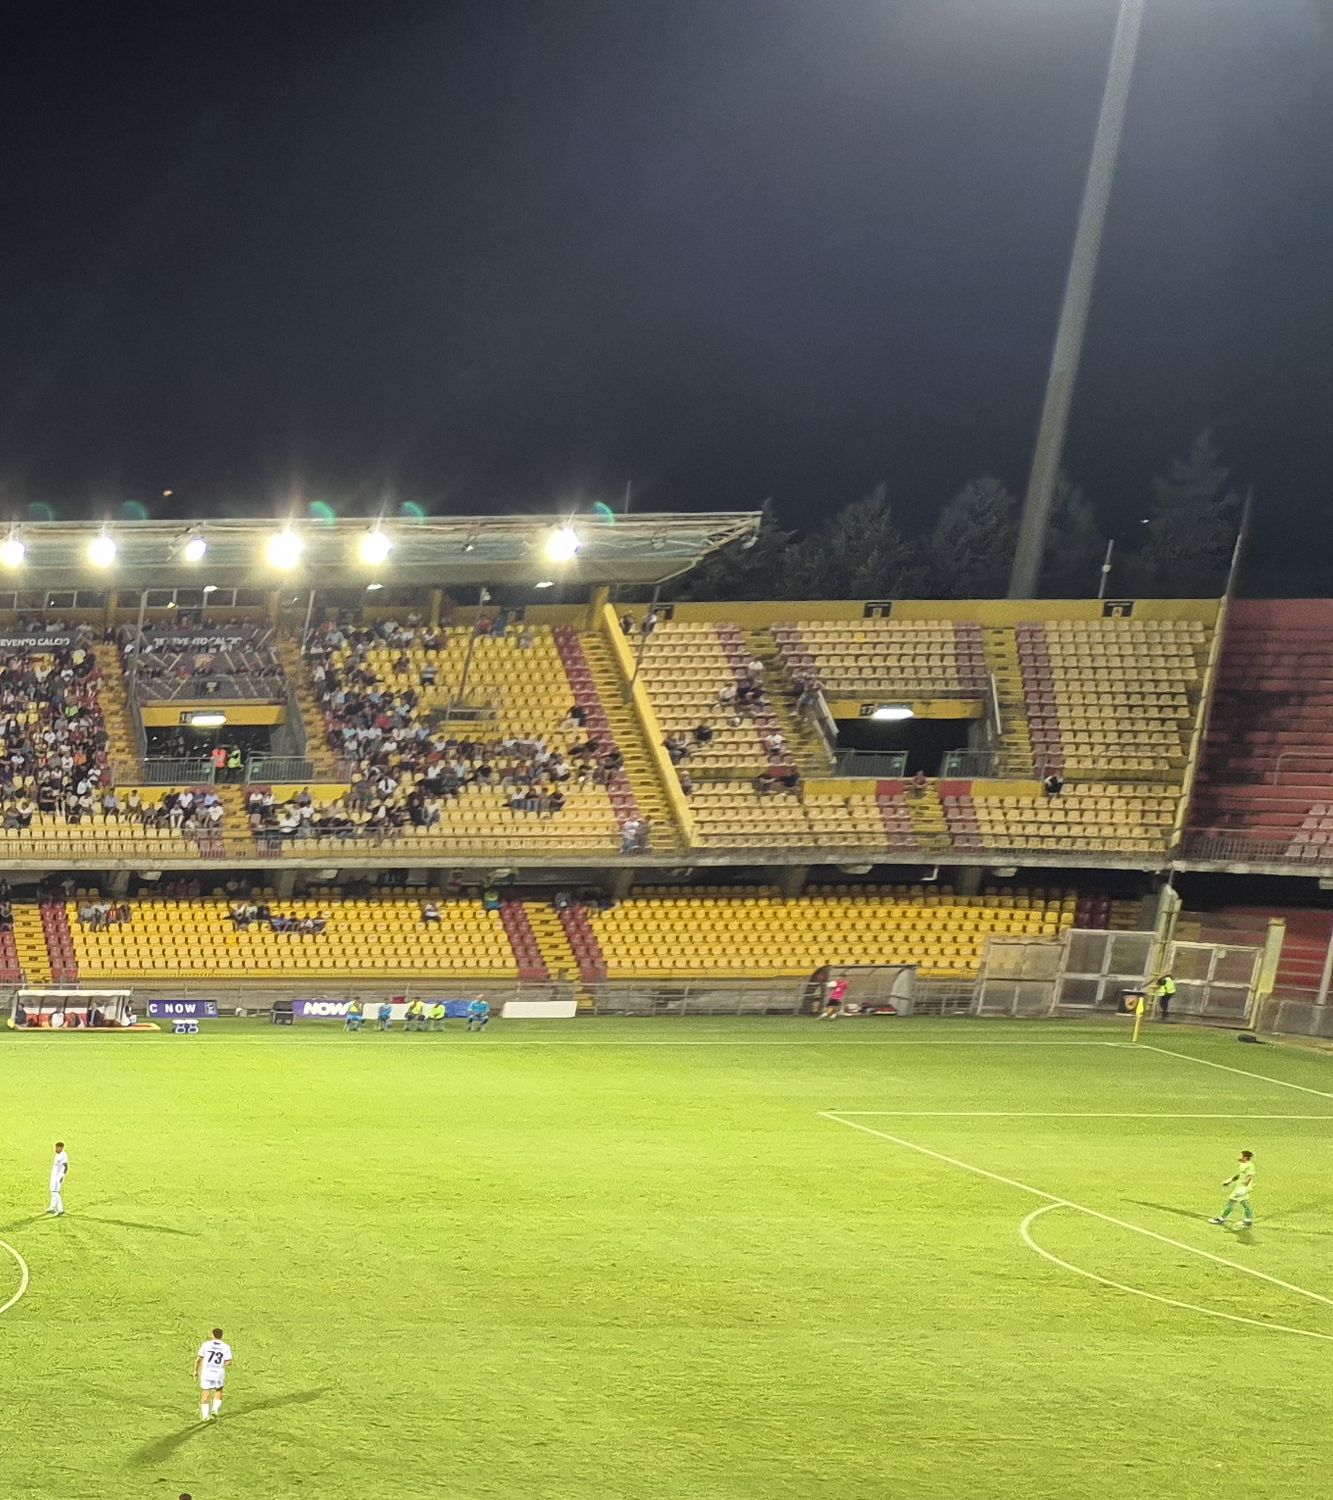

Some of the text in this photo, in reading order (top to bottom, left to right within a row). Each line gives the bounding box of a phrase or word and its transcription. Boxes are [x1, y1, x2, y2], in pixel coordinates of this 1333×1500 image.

[166, 1003, 197, 1014] NOW
[303, 1001, 348, 1016] NOW
[206, 1350, 224, 1365] 73
